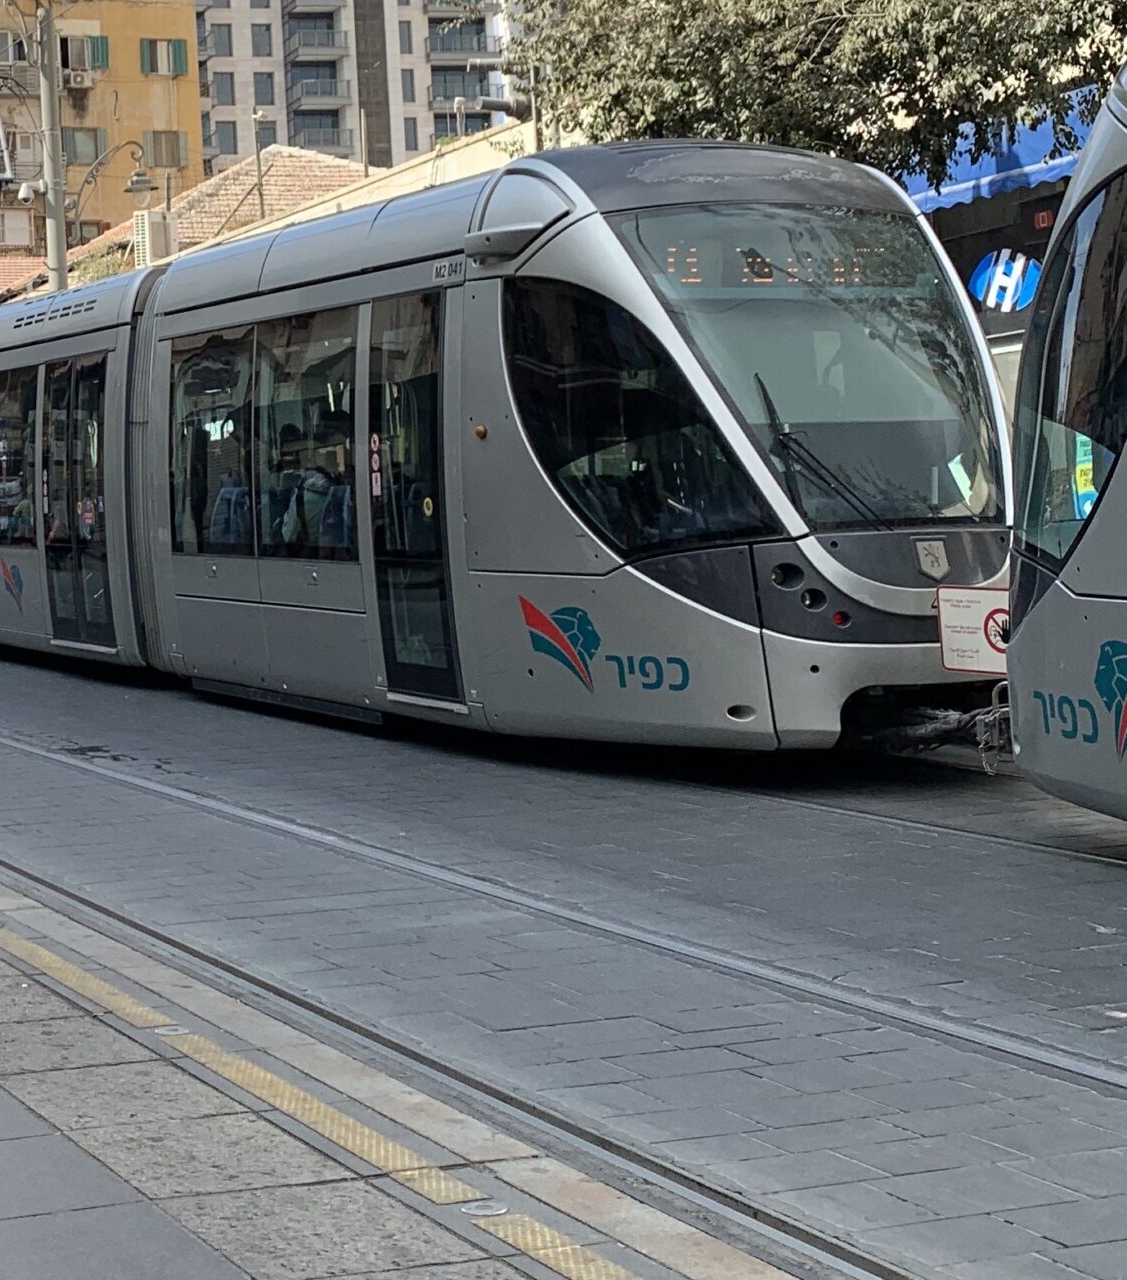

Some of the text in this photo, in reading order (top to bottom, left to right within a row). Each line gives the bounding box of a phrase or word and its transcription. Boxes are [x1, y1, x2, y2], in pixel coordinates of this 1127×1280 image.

[434, 261, 462, 280] M2 041
[605, 654, 690, 692] כפיר
[1033, 690, 1099, 744] כפיר
